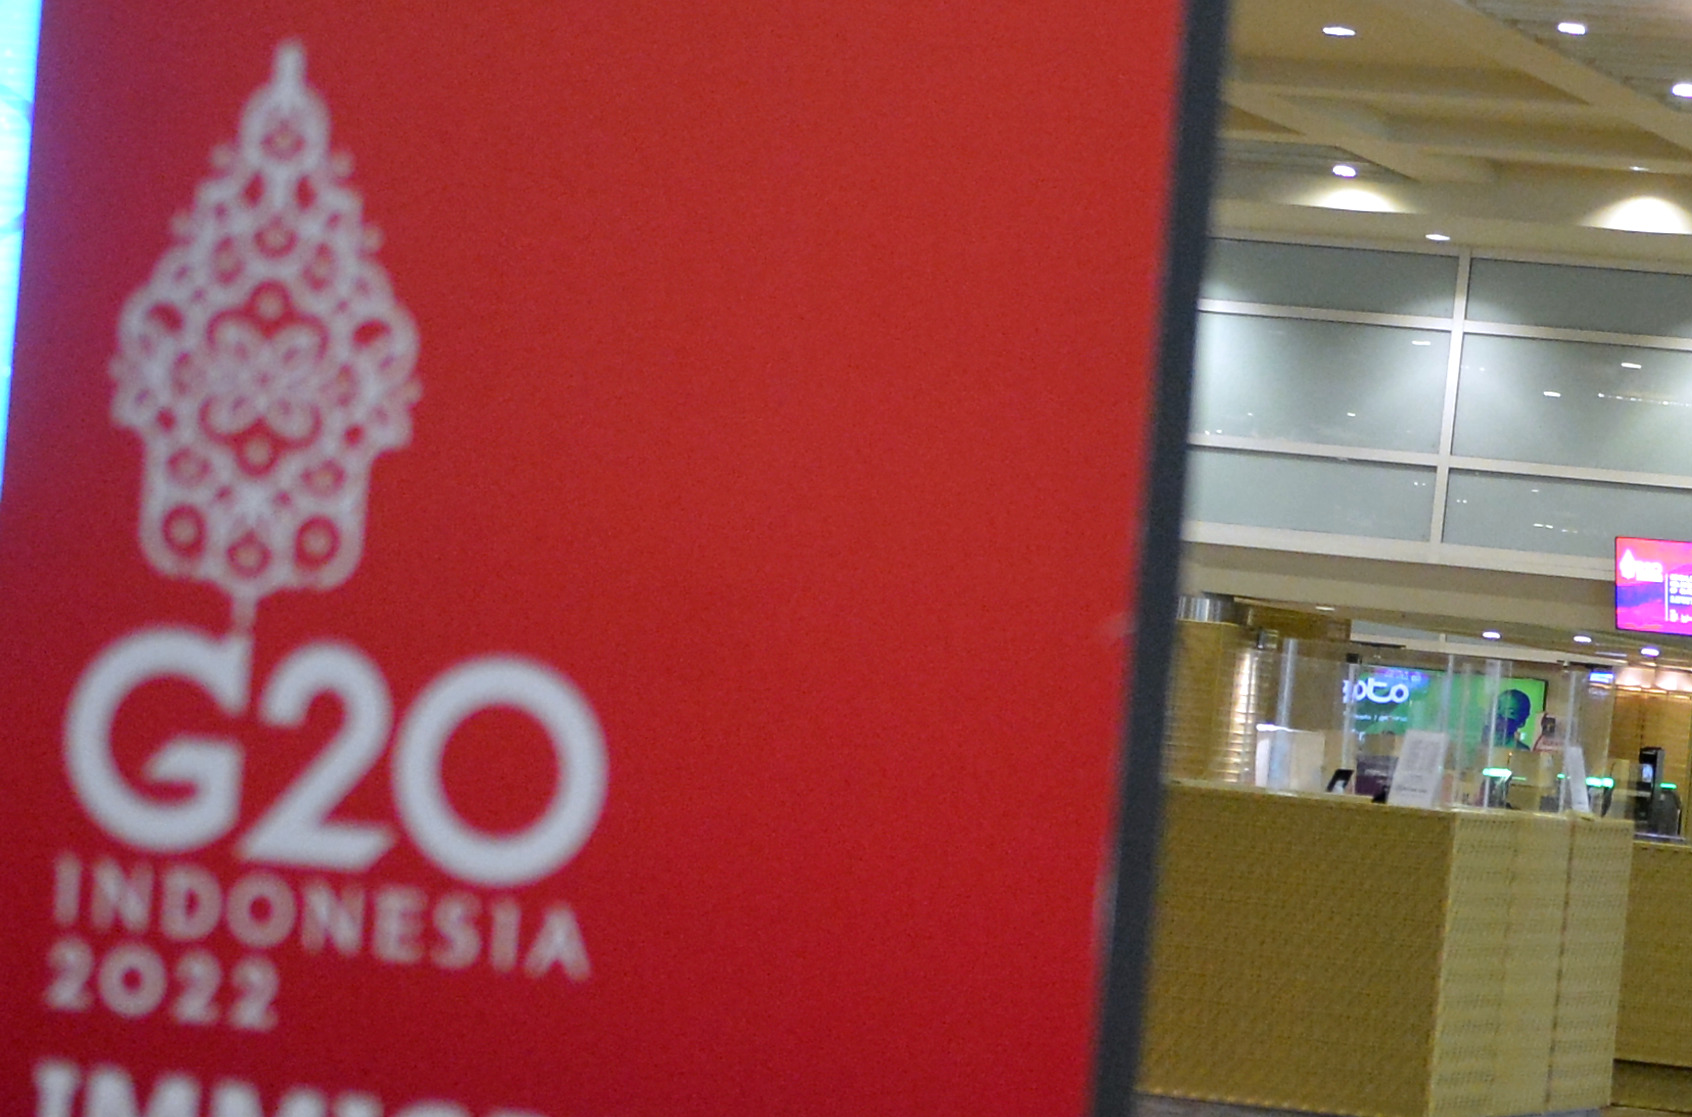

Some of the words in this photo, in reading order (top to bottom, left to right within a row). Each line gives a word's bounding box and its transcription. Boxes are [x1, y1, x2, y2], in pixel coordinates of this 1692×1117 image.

[64, 624, 607, 887] G20
[52, 853, 592, 981] INDONESIA
[44, 940, 281, 1031] 2022
